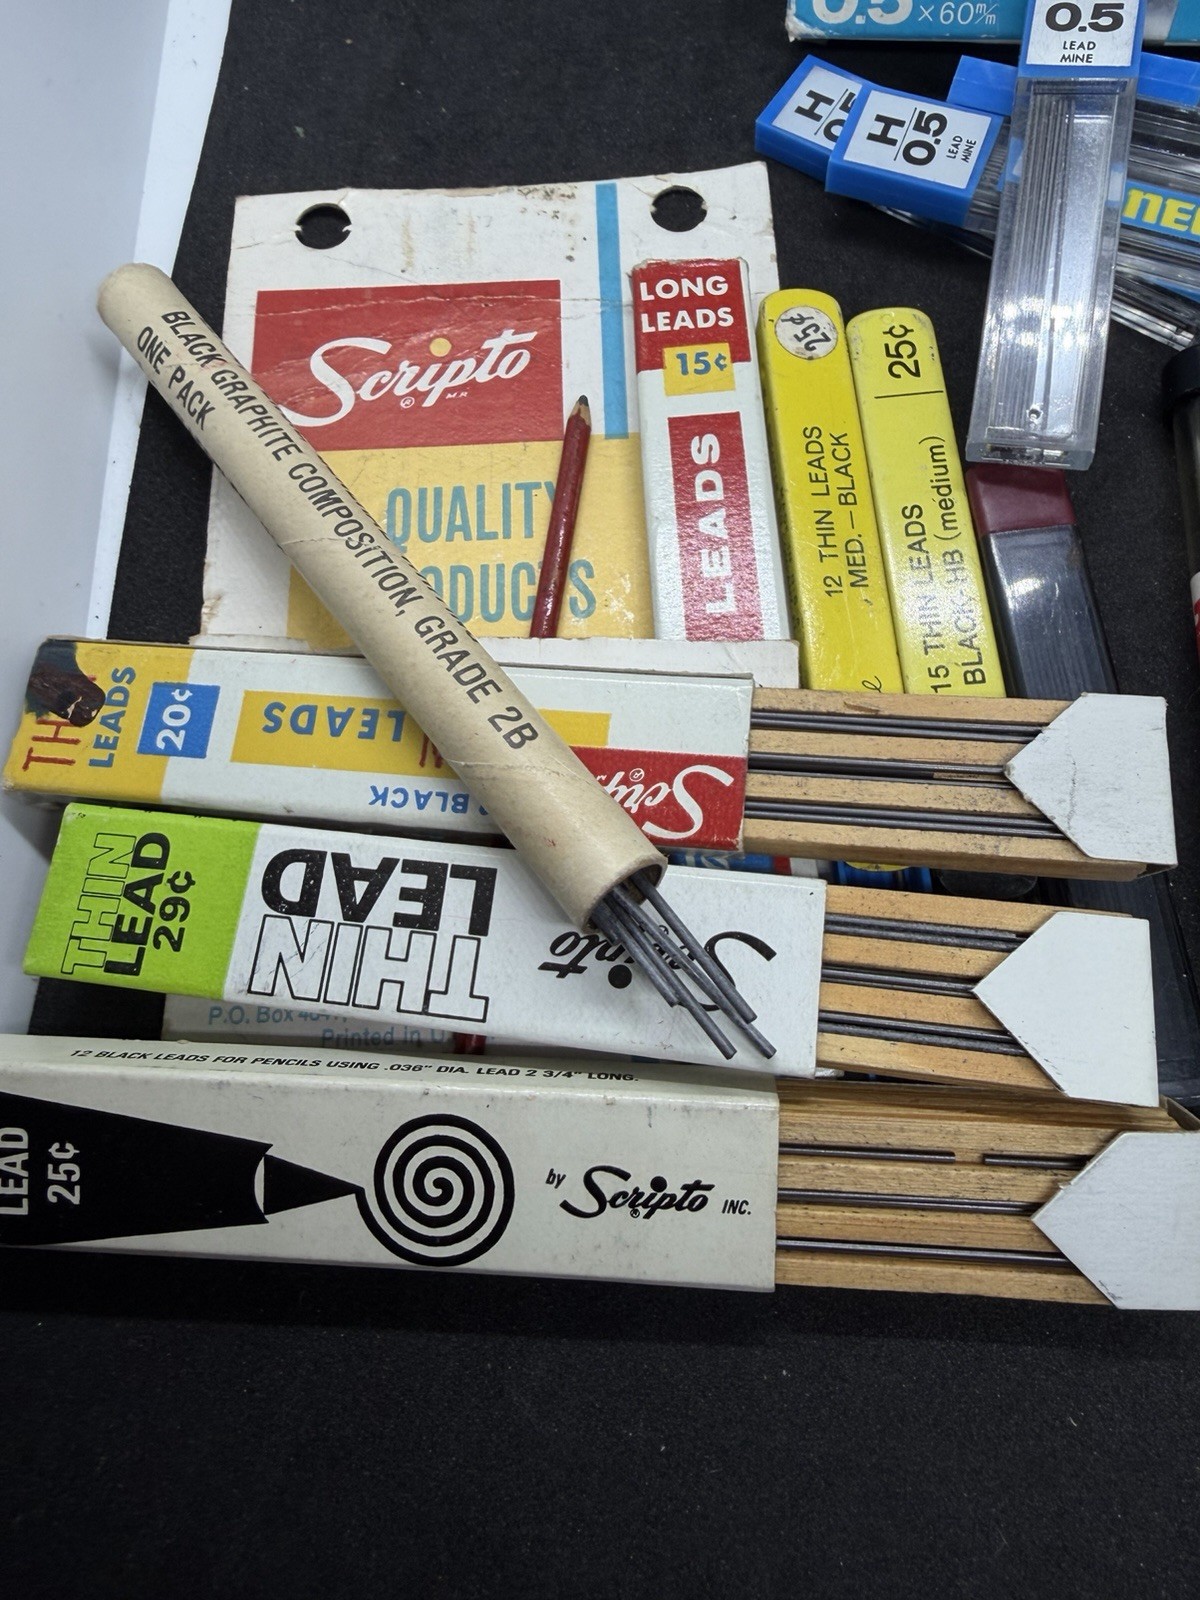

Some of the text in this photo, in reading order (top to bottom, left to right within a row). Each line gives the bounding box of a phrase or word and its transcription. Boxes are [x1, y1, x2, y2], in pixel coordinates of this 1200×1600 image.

[1045, 2, 1125, 32] 0.5
[1059, 53, 1094, 64] MINE
[1062, 40, 1096, 51] LEAD
[794, 89, 835, 123] H
[867, 113, 906, 147] H
[902, 110, 948, 166] 0.5
[946, 135, 963, 159] LEAD
[961, 139, 977, 163] MINE
[639, 275, 729, 301] LONG
[640, 307, 734, 333] LEADS
[137, 326, 216, 431] ONE PACK
[279, 329, 538, 427] Scripto
[676, 351, 728, 377] 15¢
[882, 324, 921, 379] 25¢
[161, 310, 539, 750] BLACK GRAPHITE COMPOSITION, GRADE 2B
[690, 433, 737, 614] LEADS
[802, 426, 843, 597] 12 THIN LEADS
[901, 504, 952, 693] 15 THIN LEADS
[88, 666, 136, 768] LEADS
[156, 688, 193, 751] 20¢
[261, 701, 406, 742] LEADS
[367, 784, 470, 815] BLACK
[60, 832, 137, 975] THIN
[104, 832, 170, 976] LEAD
[152, 870, 196, 953] 29¢
[260, 847, 499, 937] LEAD
[246, 914, 491, 1024] THIN
[208, 1005, 249, 1025] P.O.
[255, 1006, 294, 1024] Box
[321, 1027, 395, 1048] Printed
[94, 1050, 151, 1060] BLACK
[153, 1052, 210, 1063] LEADS
[212, 1055, 249, 1064] FOR
[250, 1057, 323, 1068] PENCILS
[326, 1060, 380, 1071] USING
[436, 1065, 470, 1075] DIA.
[476, 1067, 520, 1077] LEAD
[526, 1069, 538, 1078] 2
[587, 1071, 640, 1082] LONG.
[0, 1127, 29, 1216] LEAD
[47, 1142, 80, 1205] 25¢
[545, 1165, 752, 1219] by Scripto INC.
